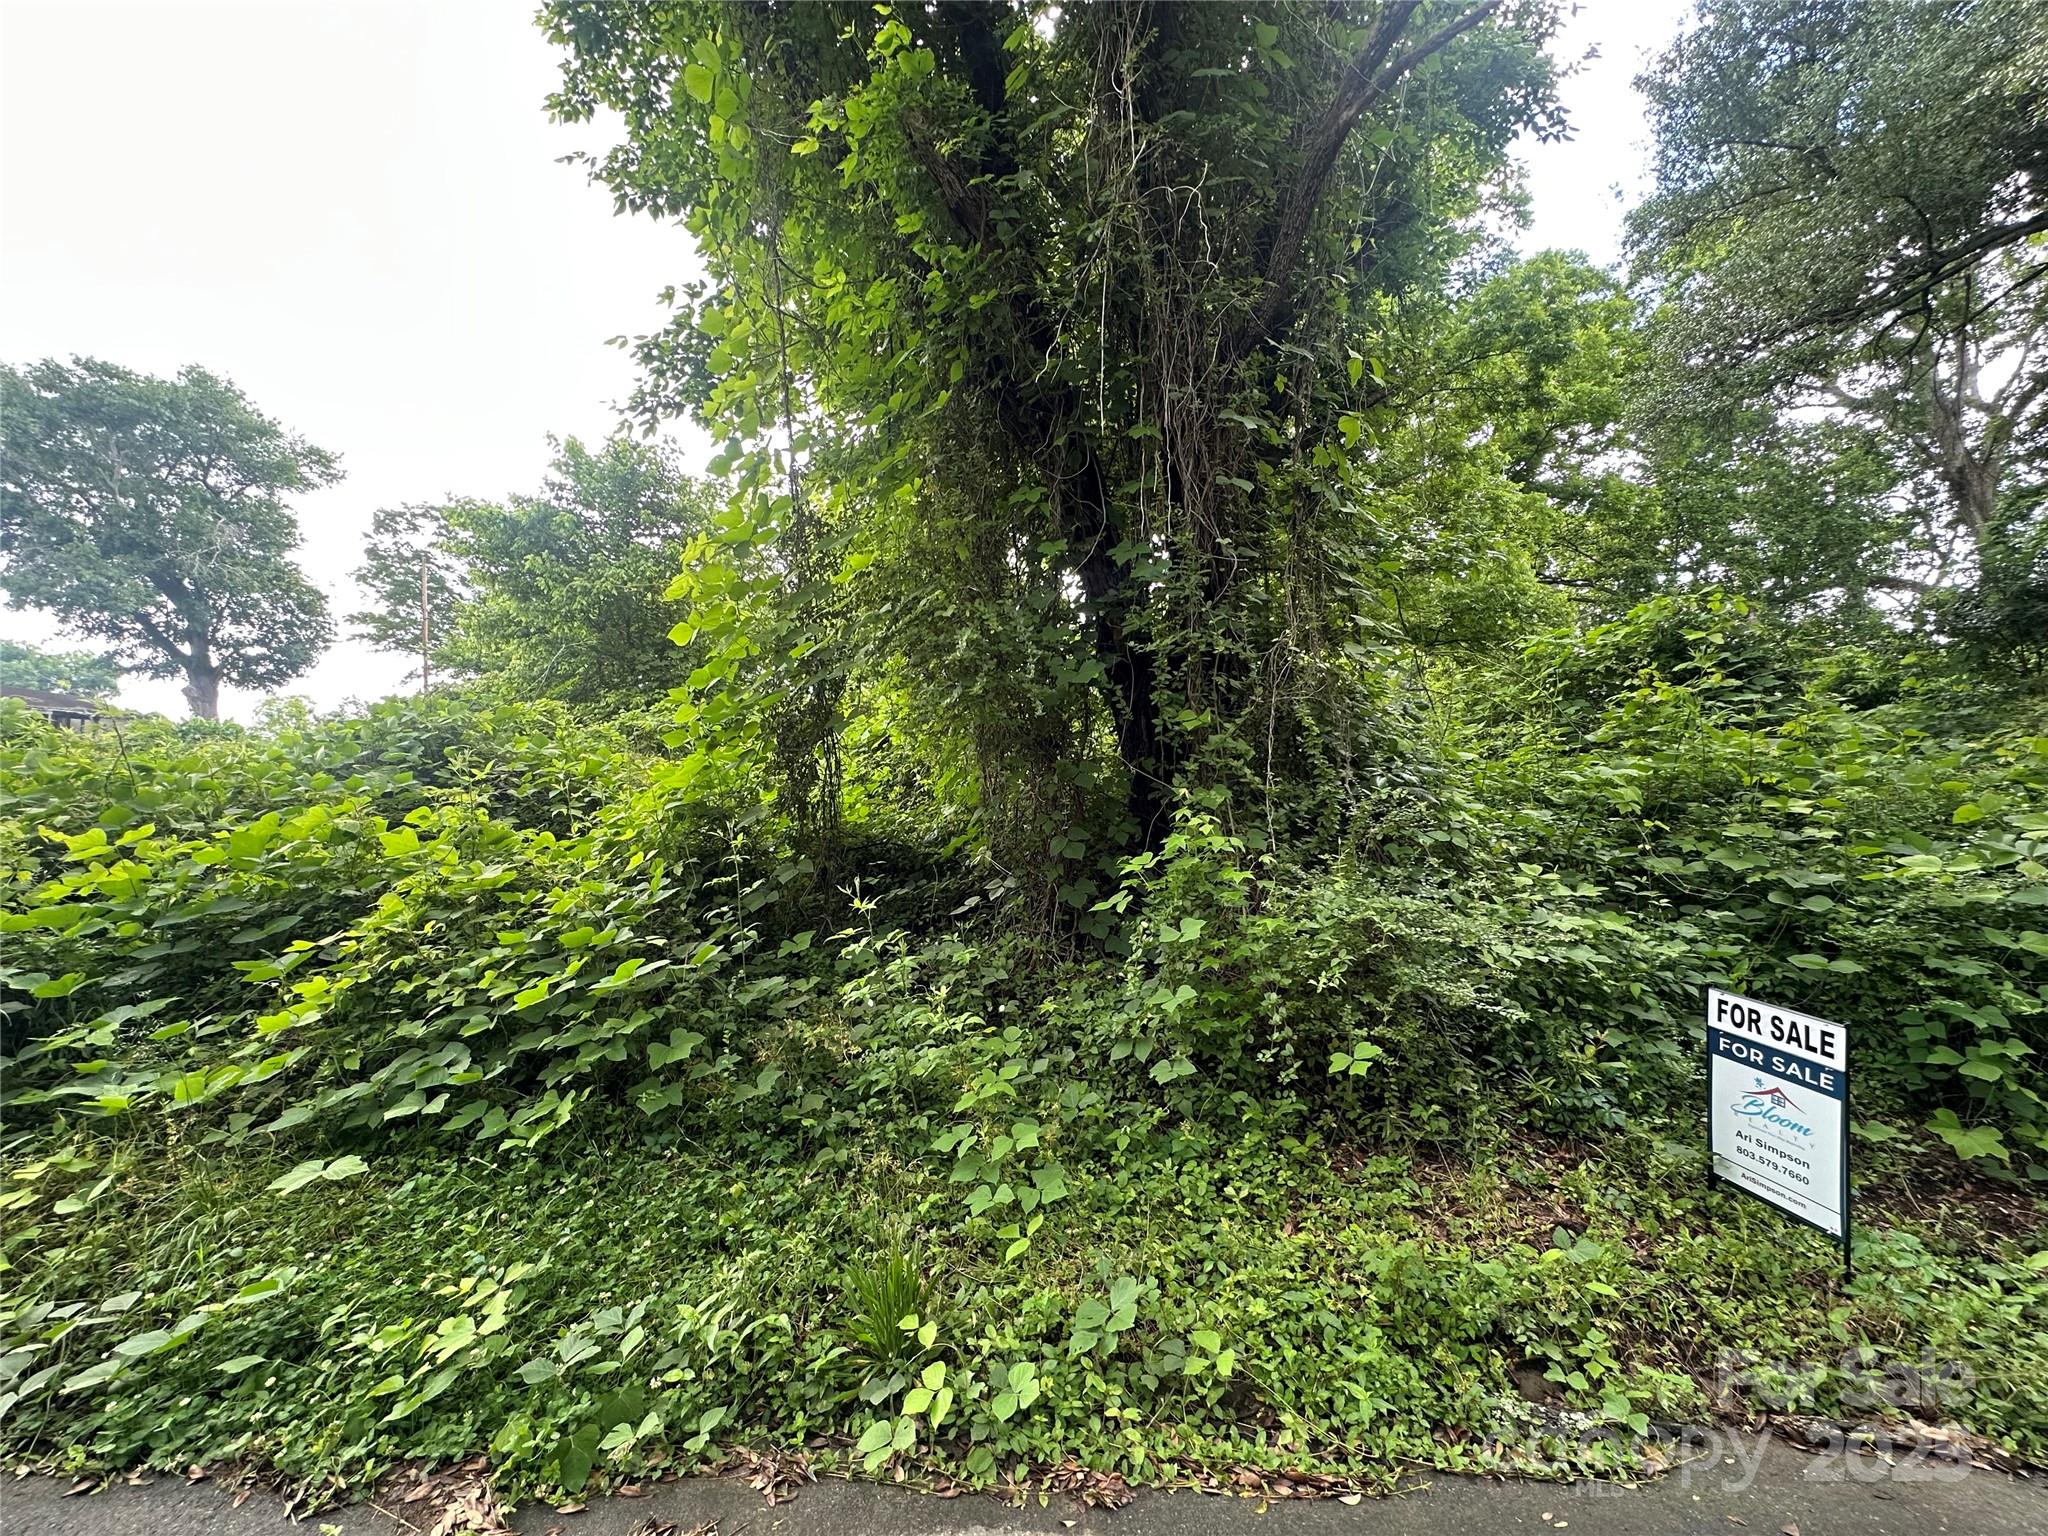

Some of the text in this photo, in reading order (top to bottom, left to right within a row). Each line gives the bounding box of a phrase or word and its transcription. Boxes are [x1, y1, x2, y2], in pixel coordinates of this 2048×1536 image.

[1717, 998, 1835, 1060] FOR SALE
[1719, 1037, 1834, 1091] FOR SALE
[1730, 1095, 1813, 1136] Bloom
[1735, 1130, 1810, 1169] Ari Simpson
[1736, 1145, 1810, 1186] 803.579.7660
[1740, 1172, 1807, 1209] AriSimpson.com
